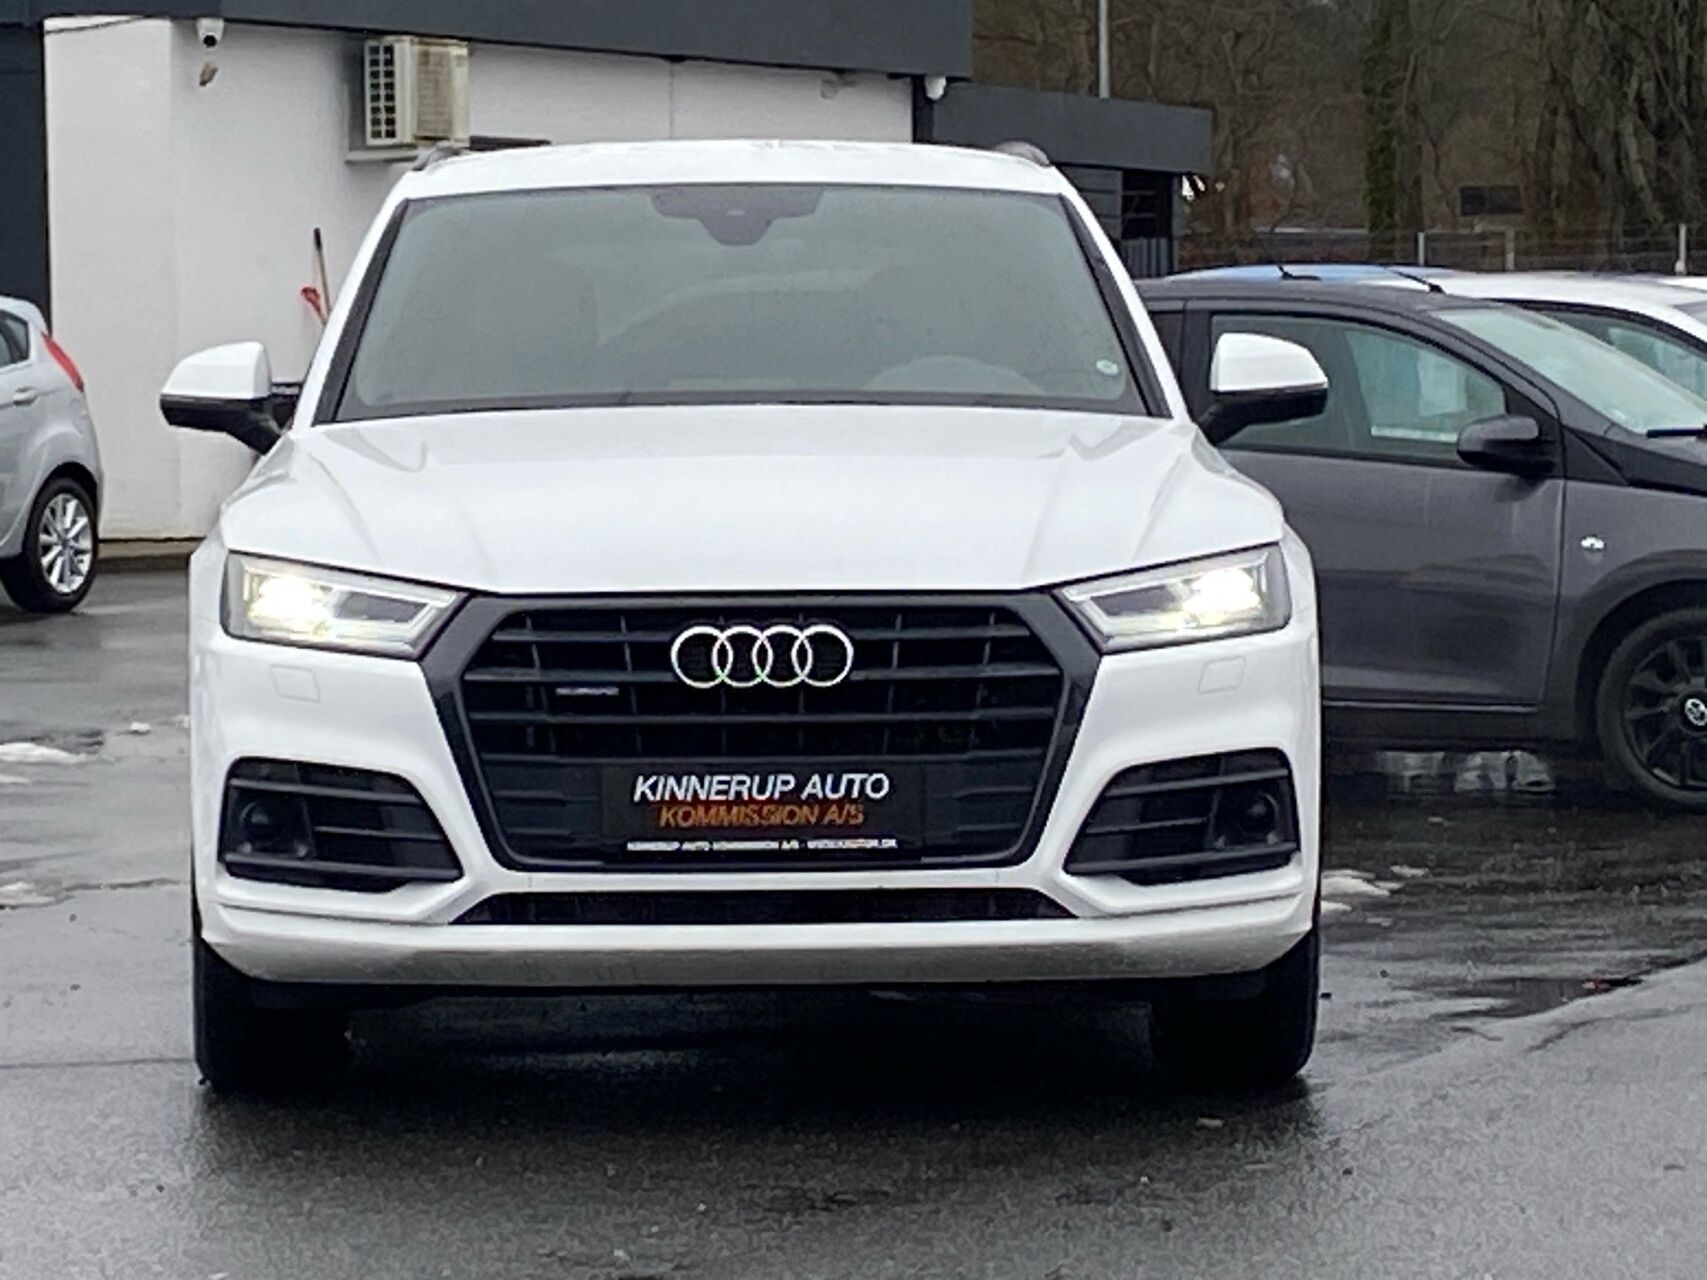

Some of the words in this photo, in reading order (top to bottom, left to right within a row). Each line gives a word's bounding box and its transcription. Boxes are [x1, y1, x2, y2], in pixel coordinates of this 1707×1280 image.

[633, 774, 796, 802] KINNERUP
[800, 773, 890, 800] AUTO
[658, 804, 819, 827] KOMMISSION
[823, 803, 865, 825] A/S
